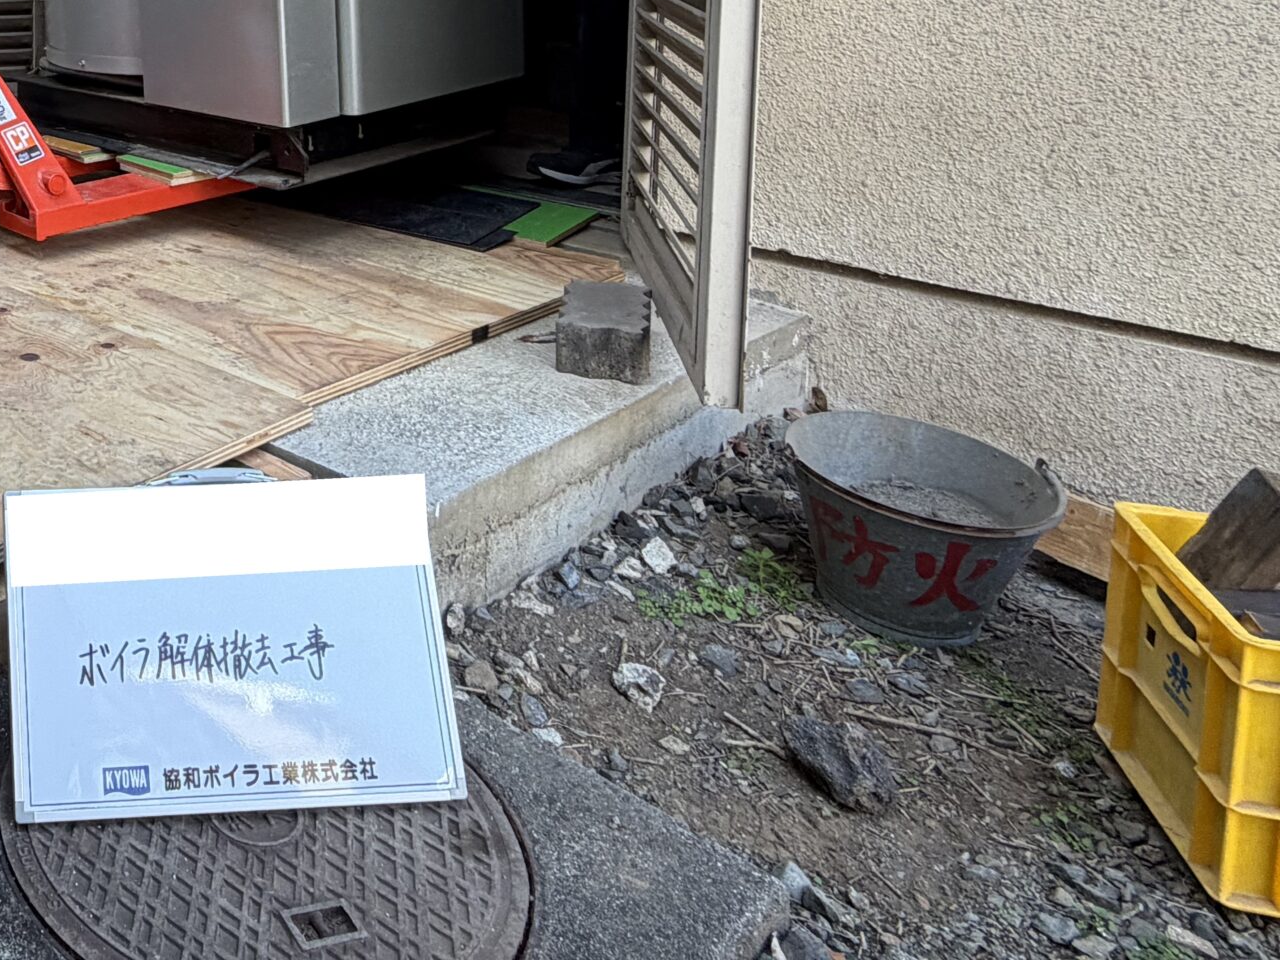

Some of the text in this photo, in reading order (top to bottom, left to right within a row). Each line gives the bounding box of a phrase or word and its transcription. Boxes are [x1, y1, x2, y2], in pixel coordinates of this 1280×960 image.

[6, 125, 30, 150] CP
[810, 494, 998, 613] 防火
[78, 623, 335, 687] ボイラ解体撤去工事
[104, 757, 378, 792] KYOWA 協和ボイラ工業株式会社
